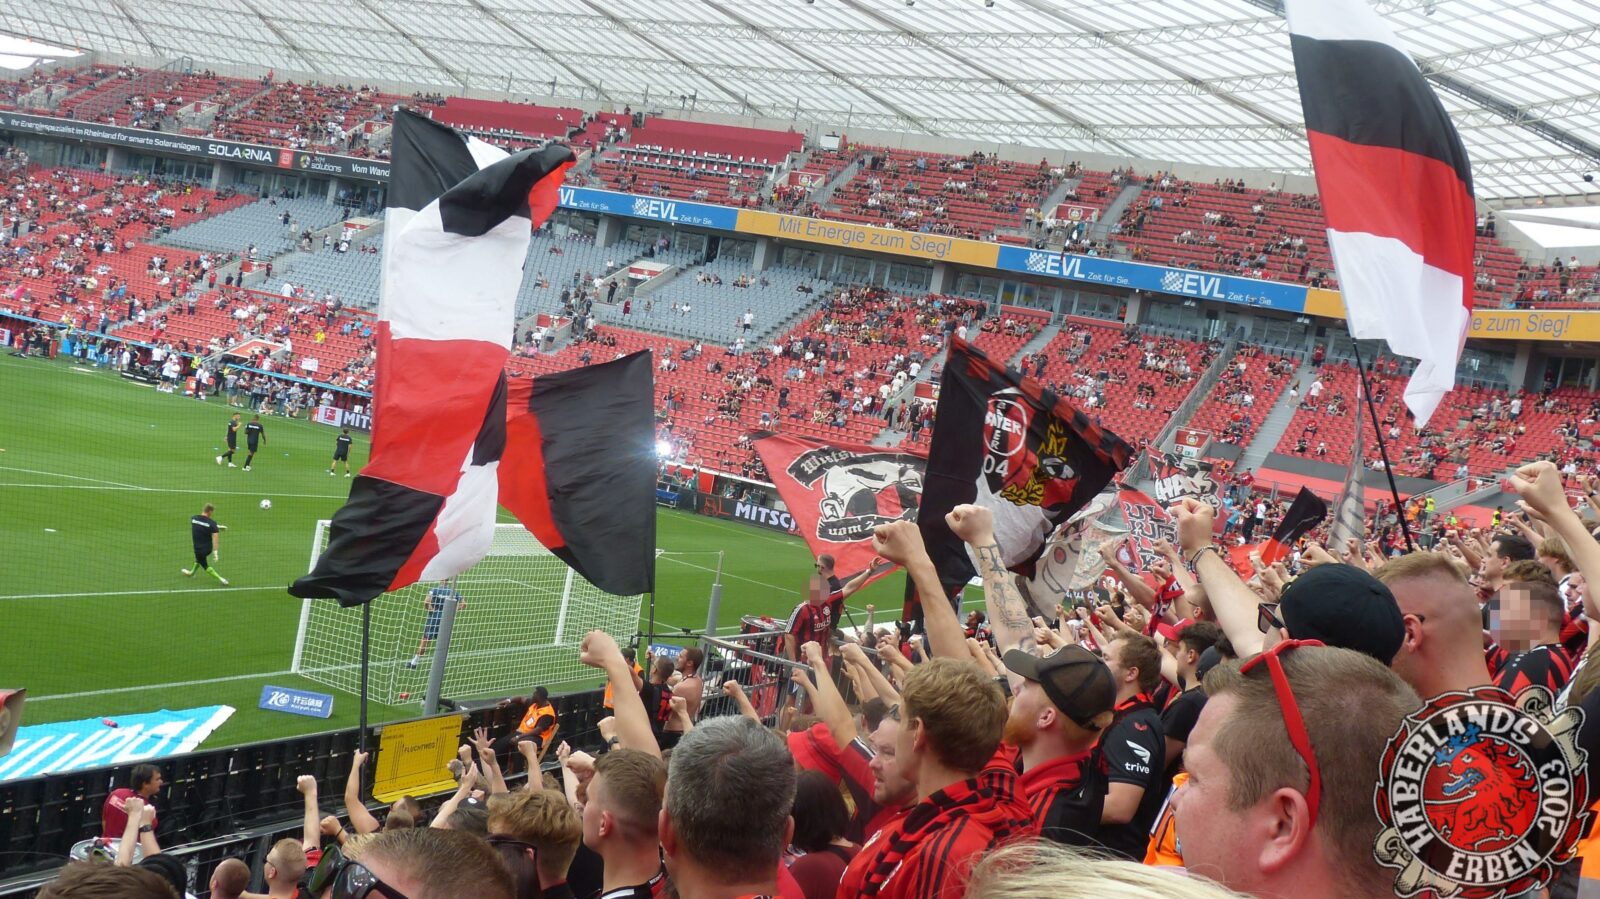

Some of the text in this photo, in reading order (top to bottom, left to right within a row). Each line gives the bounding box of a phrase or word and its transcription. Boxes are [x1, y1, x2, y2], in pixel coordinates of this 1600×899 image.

[84, 128, 117, 139] Rheinland
[128, 136, 154, 145] smarte
[208, 143, 272, 162] SOLARNIA
[351, 163, 367, 174] Vom
[557, 187, 578, 207] VL
[647, 200, 679, 221] EVL
[778, 217, 952, 258] Mit Energie zum Sieg!
[1045, 254, 1085, 279] EVL
[1087, 271, 1103, 282] Zeit
[1104, 273, 1115, 283] für
[1182, 272, 1225, 299] EVL
[1486, 317, 1520, 332] zum
[1526, 313, 1571, 337] Sieg!
[344, 411, 371, 429] MIT
[983, 455, 1009, 478] 04
[1125, 762, 1150, 774] trive
